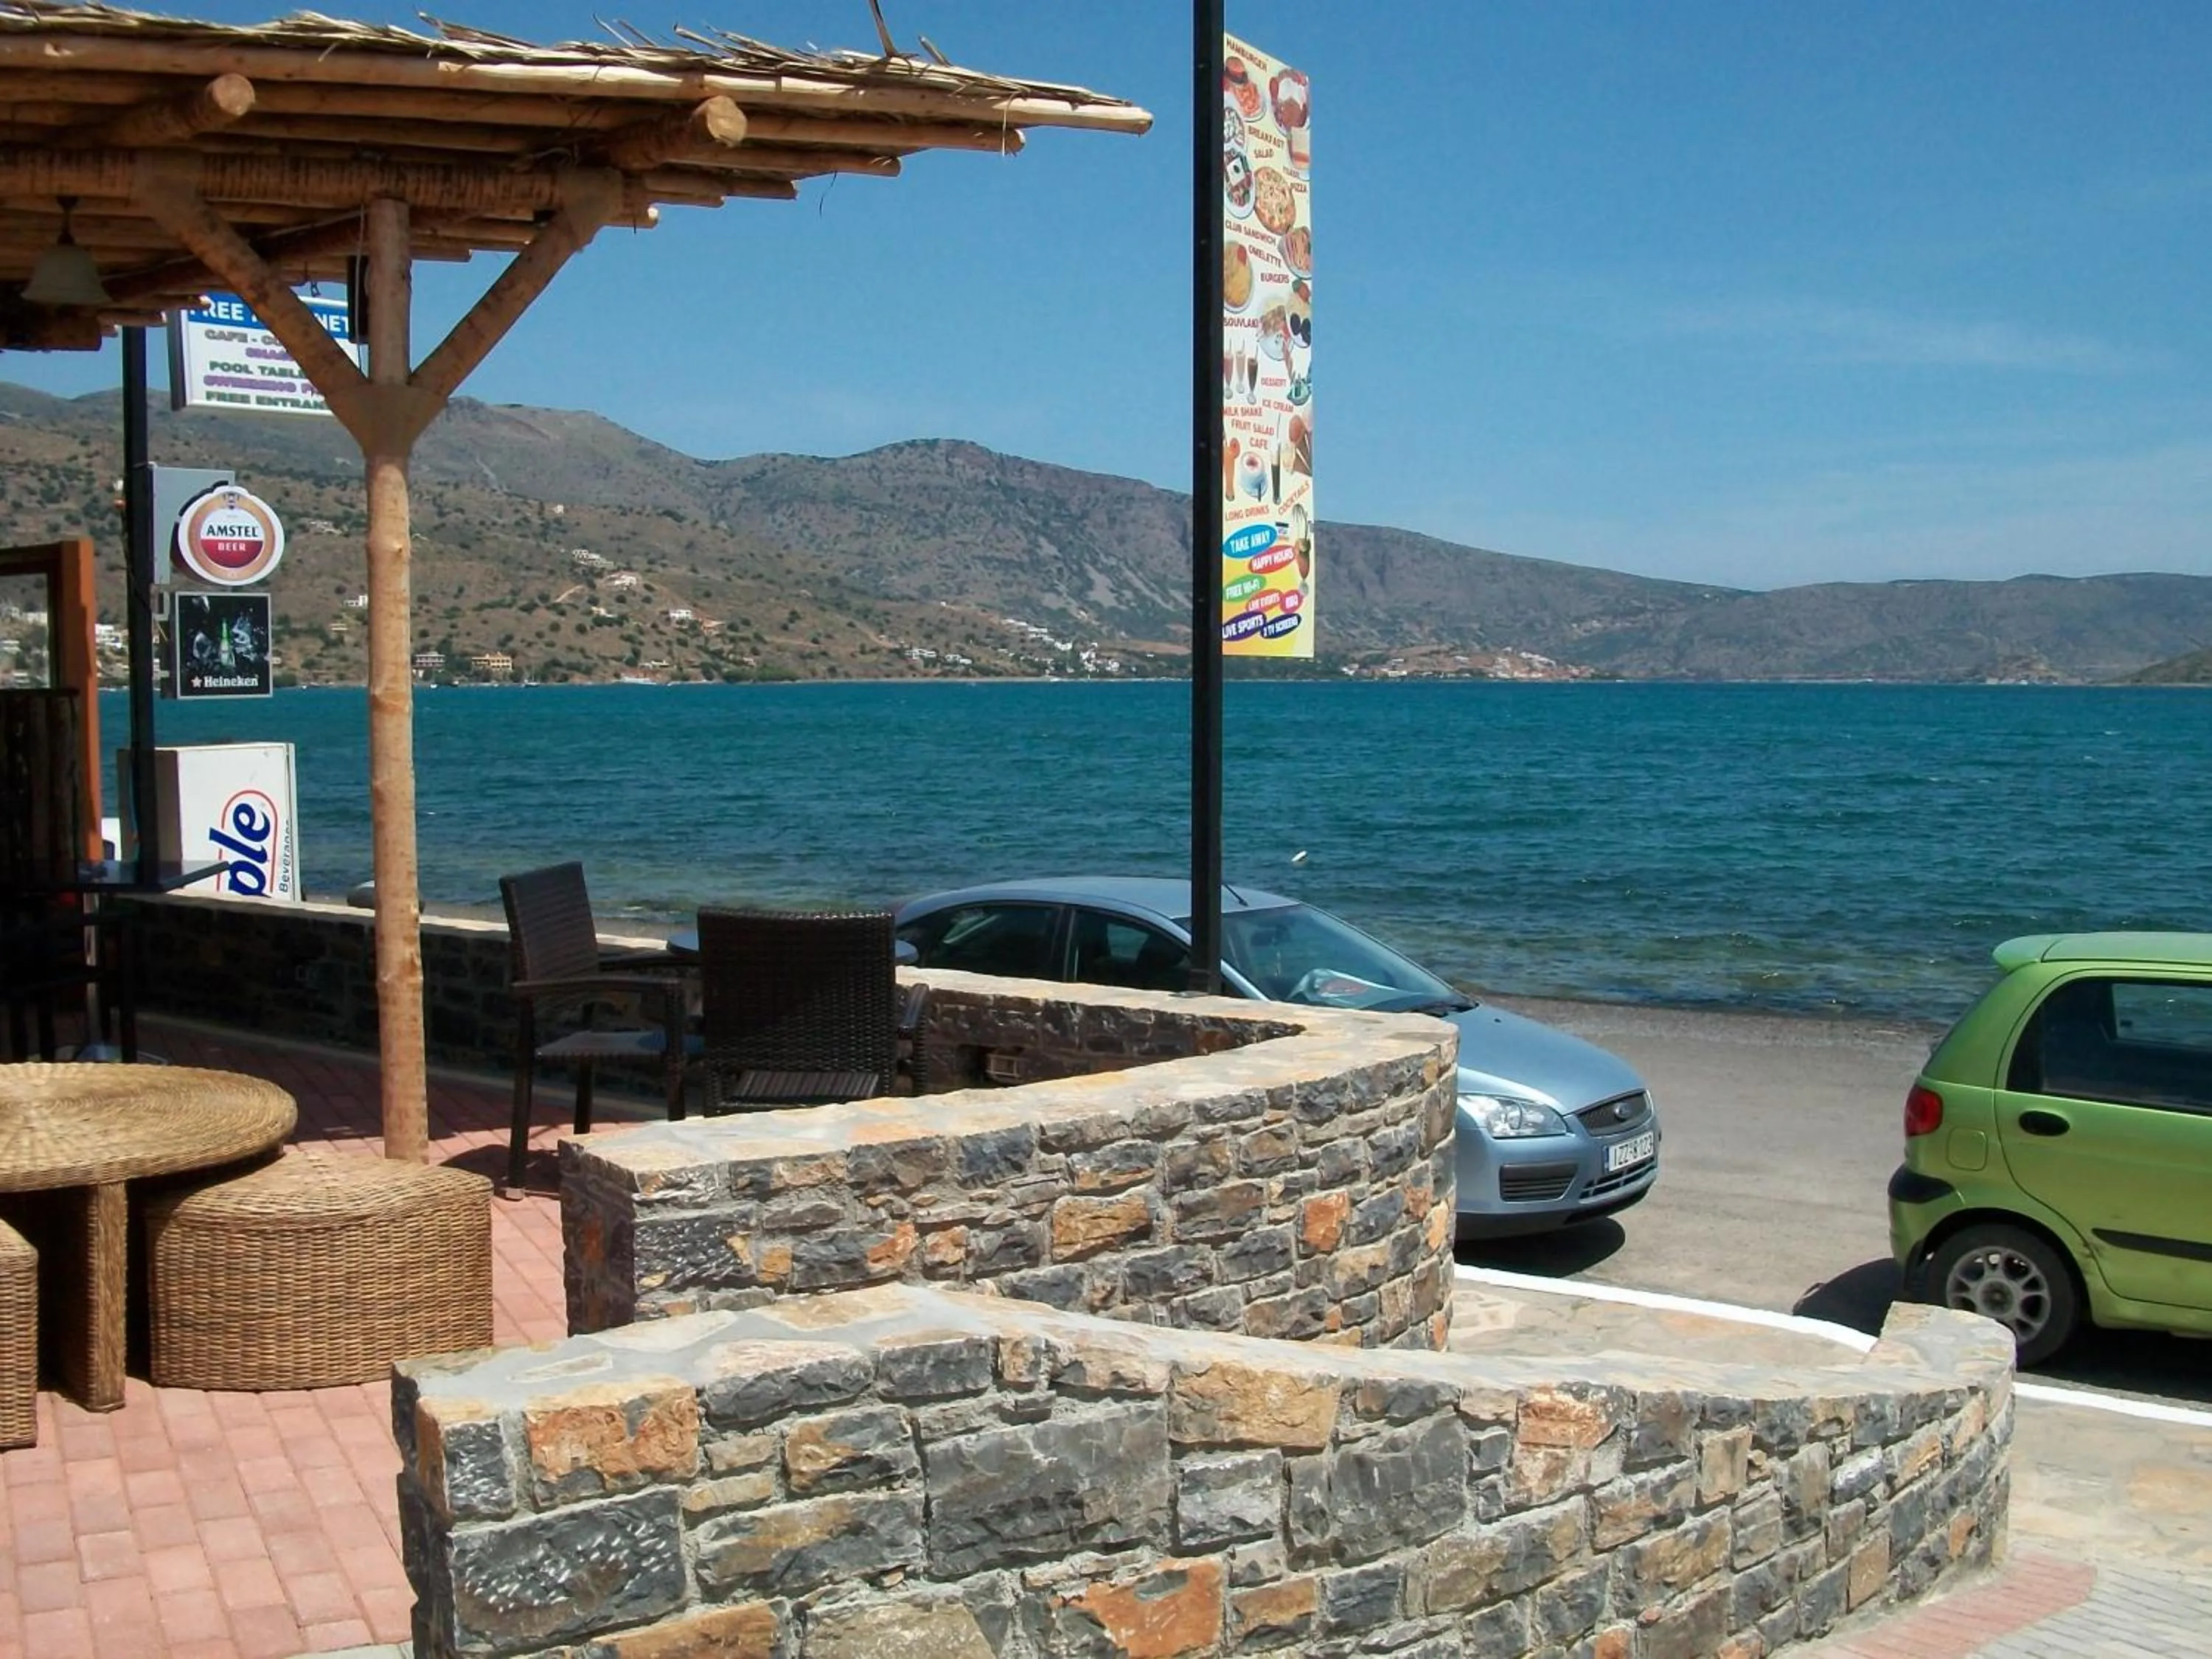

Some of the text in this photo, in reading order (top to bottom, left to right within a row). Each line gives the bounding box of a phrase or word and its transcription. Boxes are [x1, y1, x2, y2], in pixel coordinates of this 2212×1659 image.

[1226, 38, 1267, 72] HAMBURGER
[1225, 220, 1276, 246] CLUB SANDWICH
[1260, 272, 1290, 284] BURGERS
[189, 301, 244, 321] REE
[205, 329, 248, 343] CAFE
[209, 361, 253, 375] POOL
[206, 392, 251, 404] FREE
[1240, 407, 1262, 417] SHAKE
[1231, 418, 1274, 435] FRUIT SALAD
[1250, 437, 1268, 450] CAFE
[1225, 504, 1270, 521] LONG DRINKS
[206, 524, 258, 538] AMSTEL
[218, 542, 246, 552] BEER
[1230, 530, 1270, 554] TAKE AWAY
[1222, 614, 1264, 639] LIVE SPORTS
[204, 675, 259, 687] Heineken
